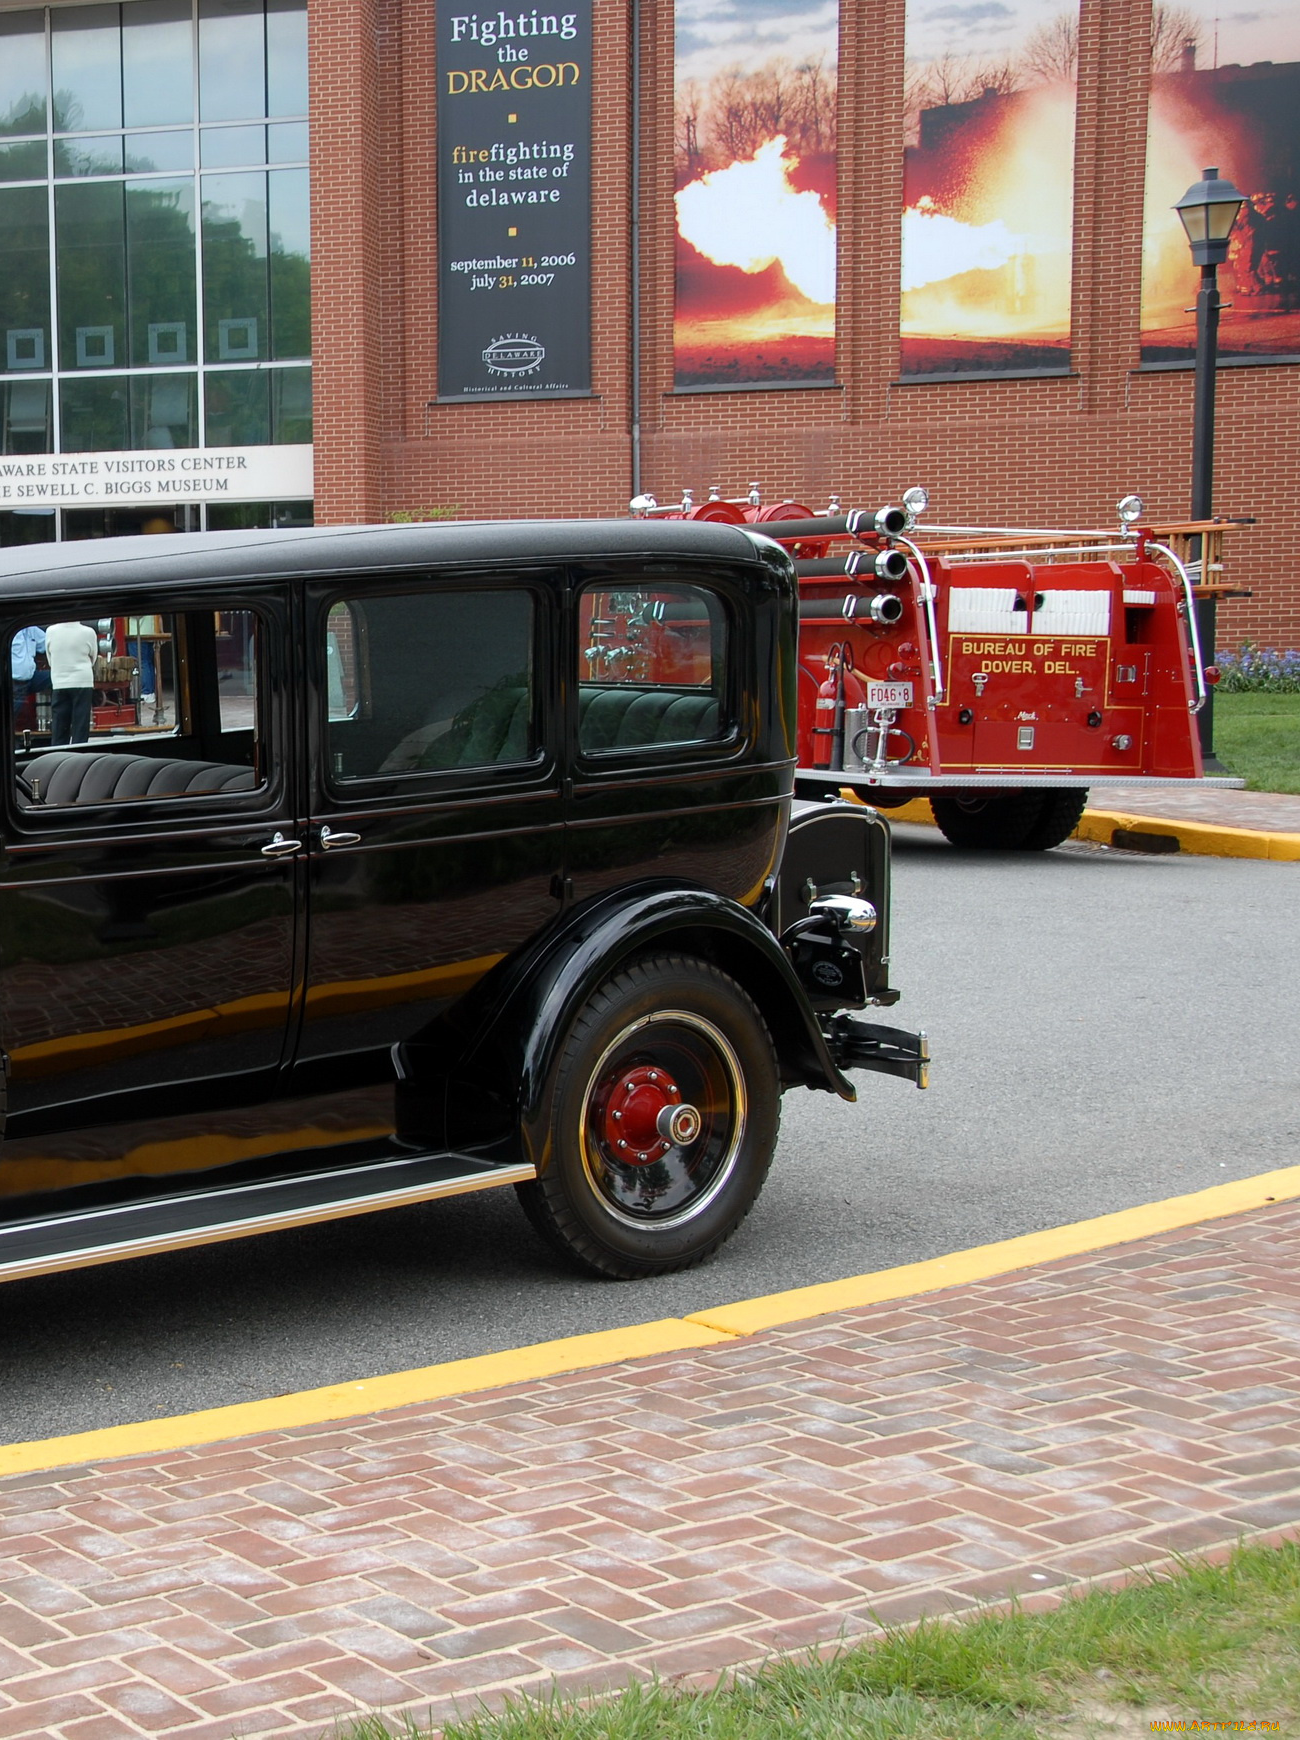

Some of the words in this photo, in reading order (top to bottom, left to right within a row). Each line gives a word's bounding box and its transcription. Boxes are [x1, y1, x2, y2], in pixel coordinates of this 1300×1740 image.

[450, 9, 577, 46] Fighting
[497, 45, 529, 63] the
[447, 62, 580, 94] DRAGON
[452, 141, 575, 165] firefighting
[458, 169, 474, 183] in
[479, 167, 505, 182] the
[509, 164, 548, 180] state
[552, 162, 570, 178] of
[466, 188, 560, 207] delaware
[450, 255, 519, 274] september
[521, 257, 538, 270] 11,
[541, 252, 576, 267] 2006
[470, 274, 497, 291] july
[499, 275, 518, 288] 31,
[520, 273, 555, 287] 2007
[491, 332, 538, 343] SAVING
[484, 350, 541, 359] DELAWARE
[487, 365, 541, 378] HISTORY
[463, 385, 497, 393] Historical
[51, 461, 100, 476] STATE
[104, 458, 176, 474] VISITORS
[181, 455, 248, 471] CENTER
[17, 482, 81, 497] SEWELL
[83, 482, 100, 496] C.
[104, 479, 153, 495] BIGGS
[157, 477, 230, 493] MUSEUM
[962, 642, 1026, 655] BUREAU
[1033, 643, 1055, 656] OF
[1061, 644, 1097, 657] FIRE
[981, 660, 1037, 675] DOVER,
[1044, 661, 1080, 674] DEL.
